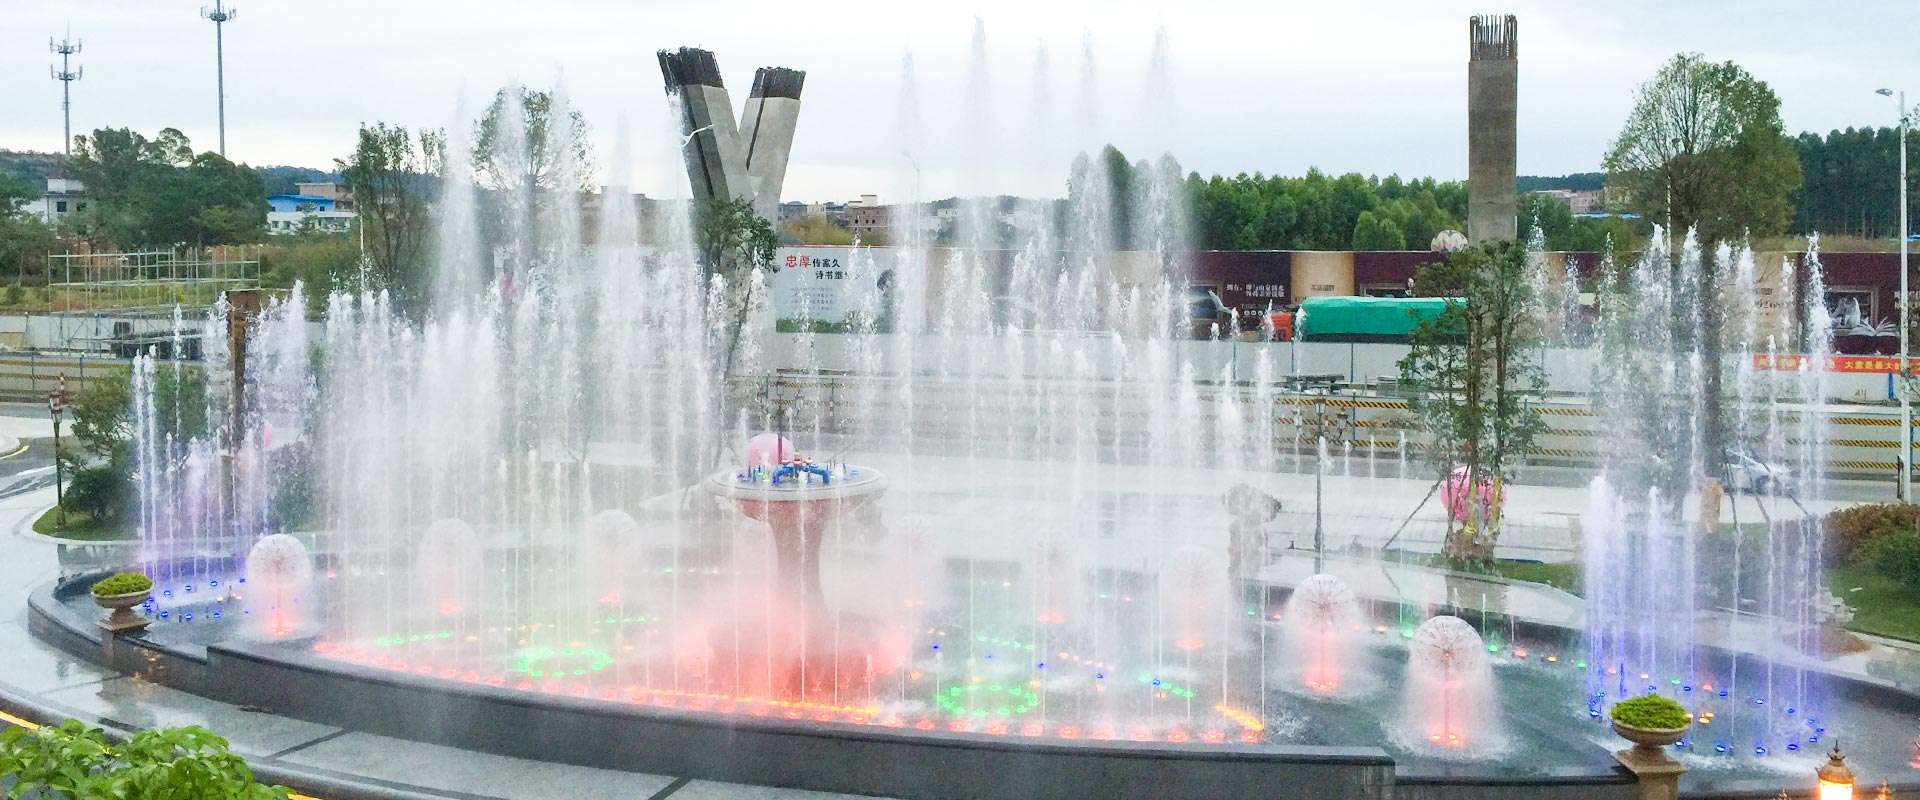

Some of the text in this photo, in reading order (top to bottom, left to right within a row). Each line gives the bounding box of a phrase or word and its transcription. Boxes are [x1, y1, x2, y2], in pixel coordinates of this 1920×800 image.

[785, 254, 840, 268] 忠厚传家久
[815, 270, 862, 280] 诗书继
